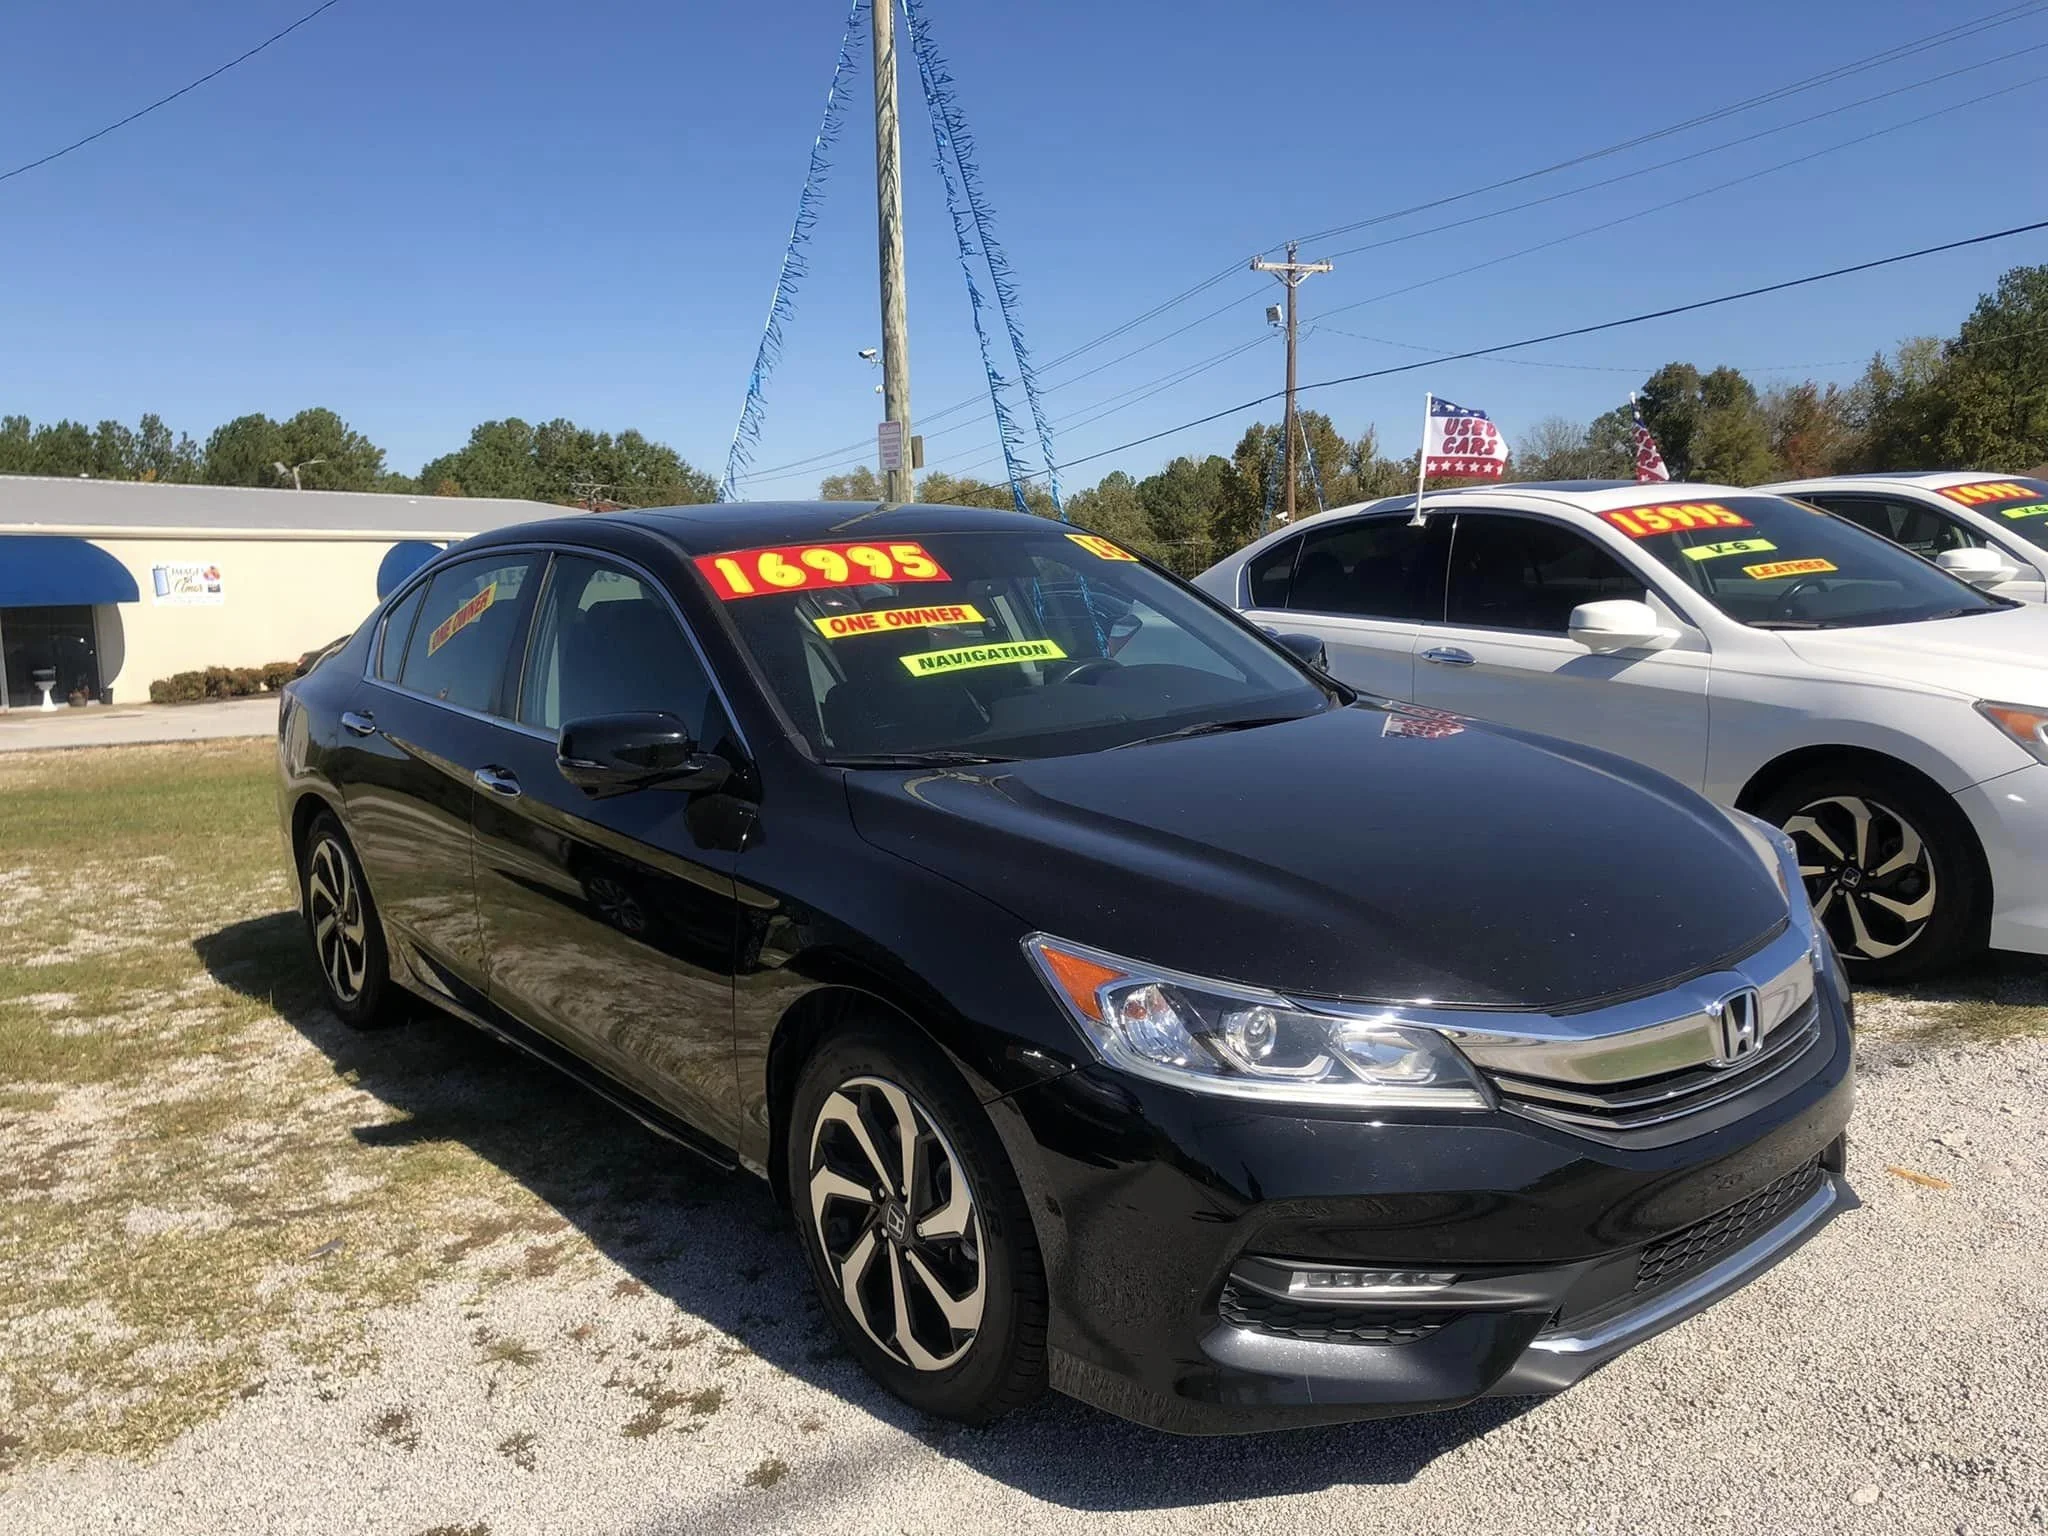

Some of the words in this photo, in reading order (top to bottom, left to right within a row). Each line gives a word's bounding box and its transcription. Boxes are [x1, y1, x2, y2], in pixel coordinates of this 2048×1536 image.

[1444, 418, 1497, 437] USED
[1442, 437, 1497, 456] CARS
[1609, 504, 1744, 534] 15995
[1707, 542, 1750, 554] V-6
[715, 545, 938, 594] 16995
[1751, 560, 1830, 577] LEATHER
[830, 613, 880, 635] ONE
[885, 606, 969, 627] OWNER
[918, 644, 1049, 670] NAVIGATION
